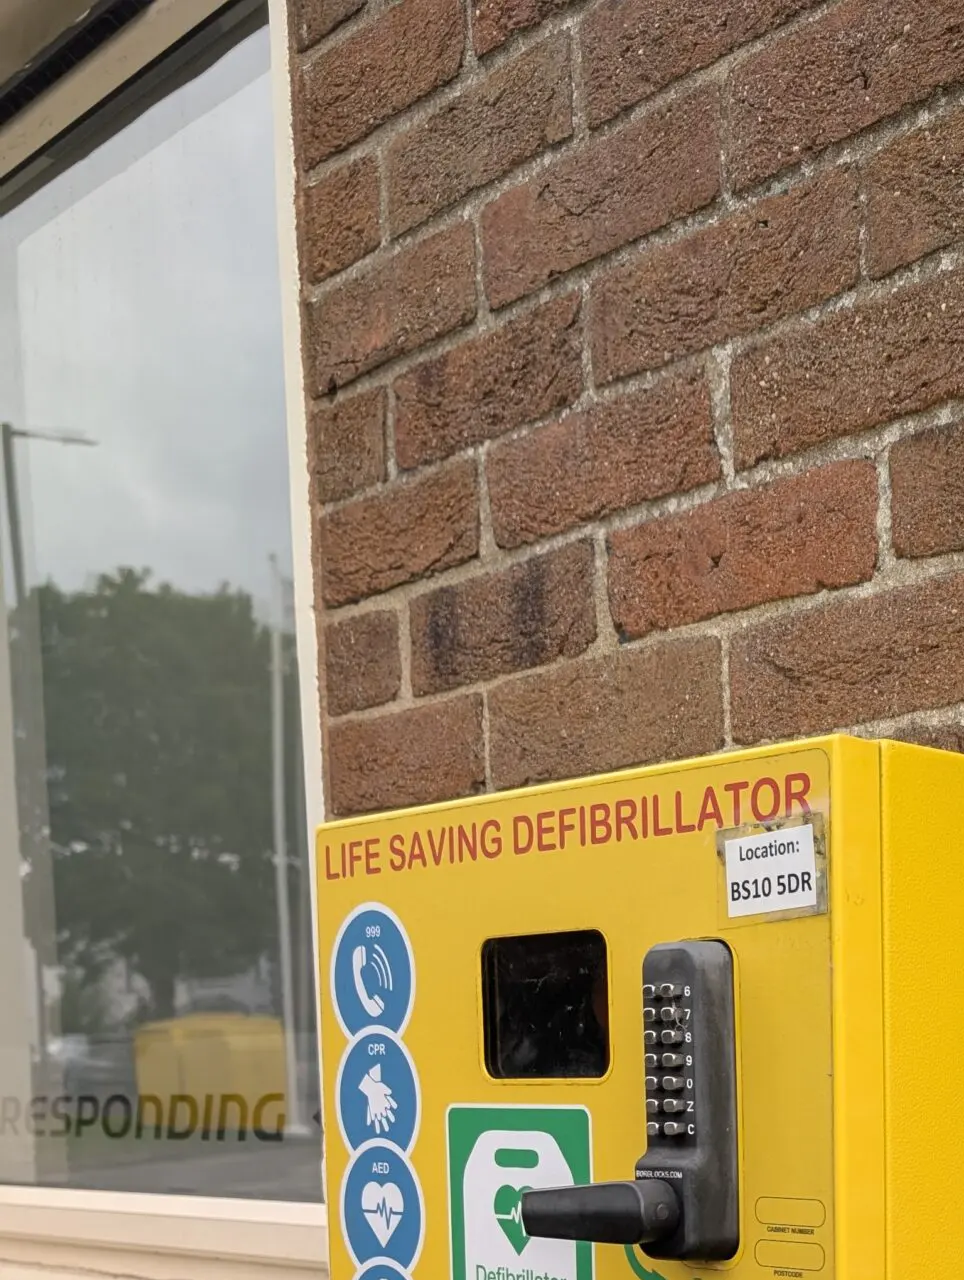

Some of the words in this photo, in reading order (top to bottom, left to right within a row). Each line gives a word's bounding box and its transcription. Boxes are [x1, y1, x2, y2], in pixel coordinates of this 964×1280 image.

[326, 838, 381, 880] LIFE
[390, 819, 502, 871] SAVING
[512, 773, 811, 855] DEFIBRILLATOR
[739, 839, 799, 861] Location:
[731, 877, 772, 901] BS10
[777, 871, 812, 895] 5DR
[365, 926, 380, 937] 999
[684, 986, 691, 996] 6
[684, 1010, 691, 1020] 7
[685, 1032, 692, 1043] 8
[368, 1043, 385, 1055] CPR
[686, 1055, 693, 1066] 9
[687, 1102, 694, 1112] Z
[0, 1093, 286, 1142] RESPONDING
[687, 1124, 695, 1134] C
[372, 1162, 389, 1174] AED
